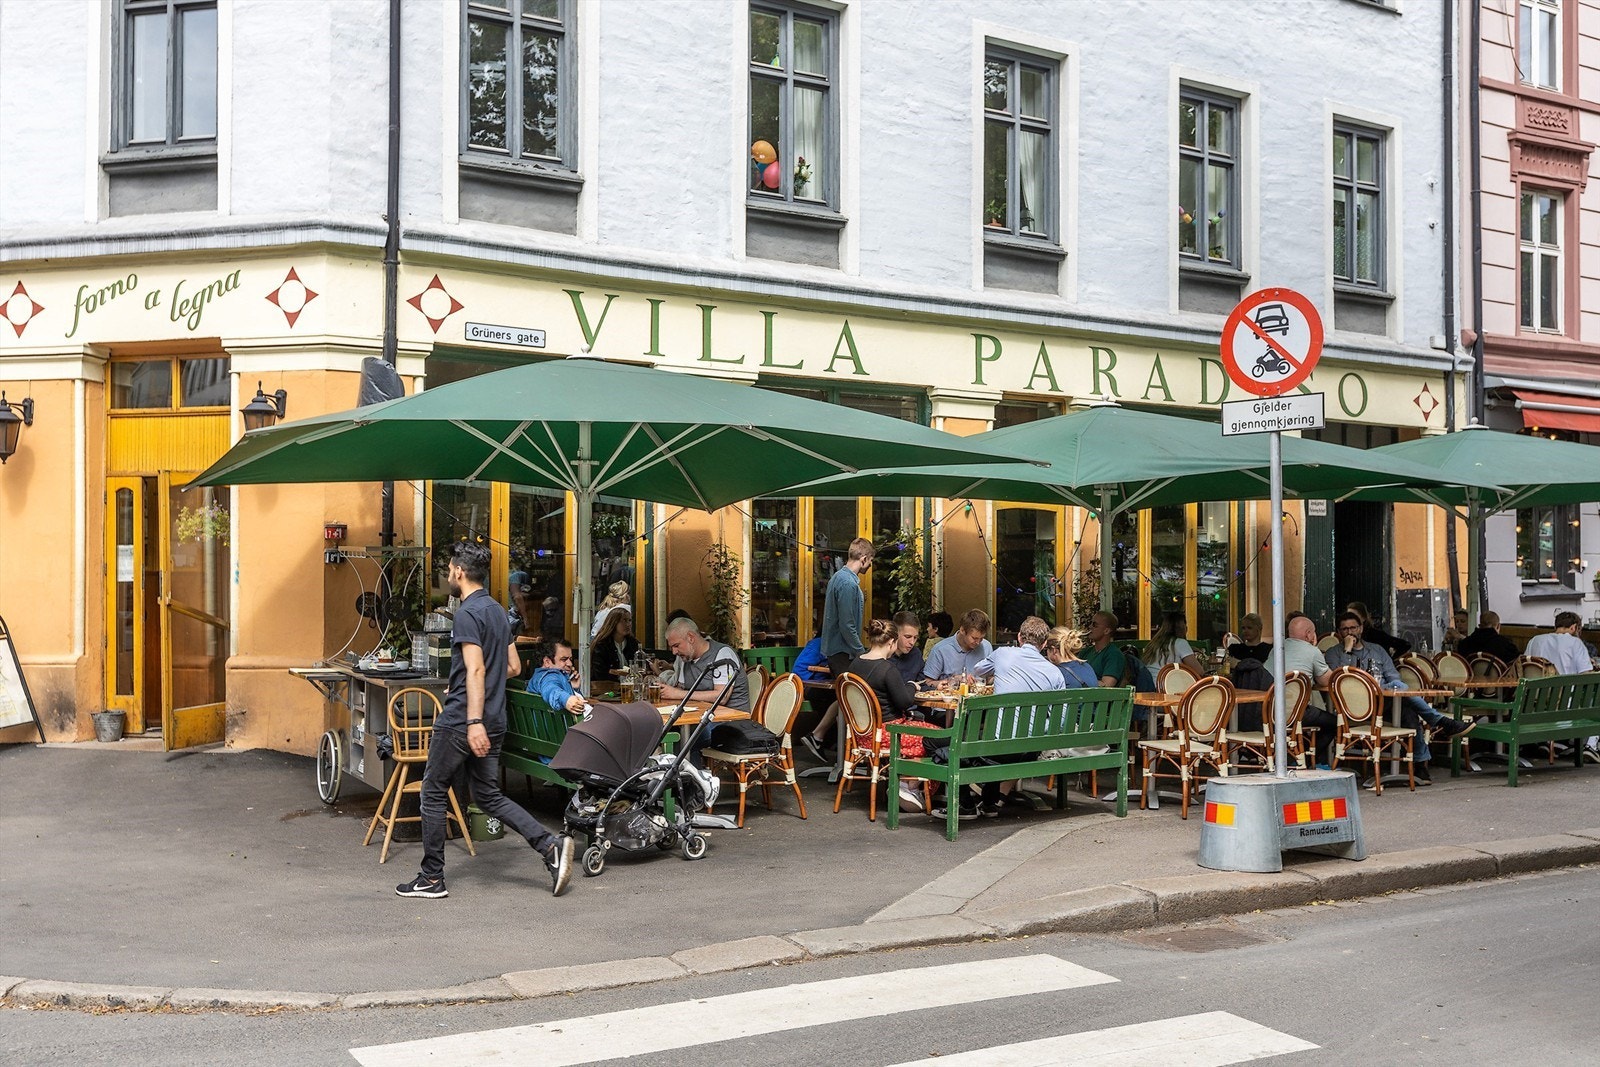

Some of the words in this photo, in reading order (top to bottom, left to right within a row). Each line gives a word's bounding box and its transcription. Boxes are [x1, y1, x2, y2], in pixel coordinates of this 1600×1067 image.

[65, 273, 138, 338] forno
[145, 289, 161, 310] a
[170, 269, 242, 331] legna
[472, 327, 512, 341] Grüners
[517, 333, 540, 344] gate
[562, 289, 870, 376] VILLA
[970, 333, 1368, 418] PARADO
[1253, 401, 1292, 415] Gjelder
[1231, 414, 1315, 433] gjennomkjøring
[1300, 825, 1338, 837] Ramudden
